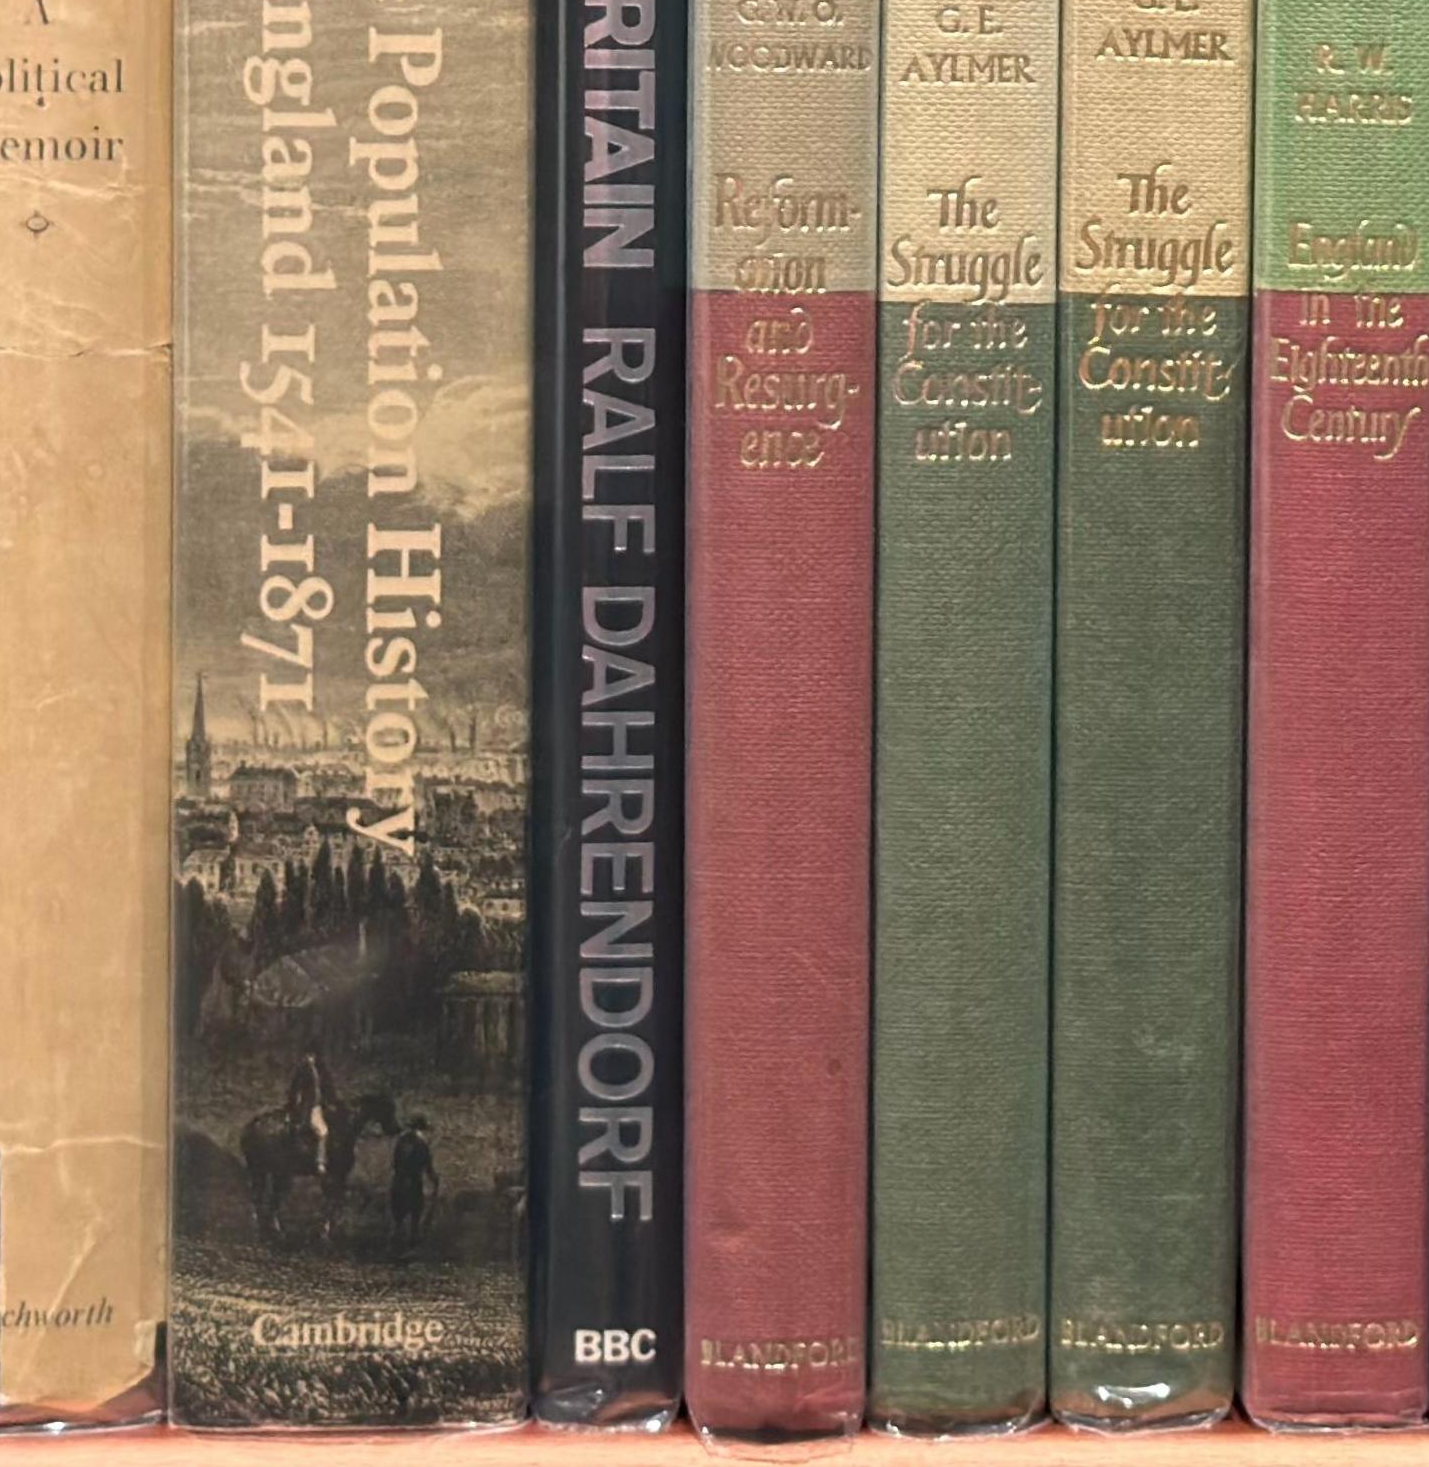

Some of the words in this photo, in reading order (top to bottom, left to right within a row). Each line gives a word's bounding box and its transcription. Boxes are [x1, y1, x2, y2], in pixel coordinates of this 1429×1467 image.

[707, 45, 873, 73] WOODWARD
[899, 54, 1037, 87] AYLMER
[1096, 29, 1235, 65] AYLMER
[1295, 92, 1412, 124] HARRIS
[927, 175, 1002, 234] The
[1117, 162, 1194, 219] The
[349, 28, 445, 495] Population
[888, 234, 1044, 306] Struggle
[1074, 216, 1234, 293] Struggle
[1288, 219, 1419, 281] England
[747, 307, 814, 355] and
[898, 298, 961, 362] for
[970, 304, 1028, 350] the
[1087, 284, 1149, 345] for
[1157, 292, 1217, 336] the
[1354, 289, 1404, 327] the
[581, 327, 655, 555] RALF
[740, 429, 825, 469] ence
[1282, 393, 1421, 461] Century
[239, 322, 335, 713] 1541-1871
[348, 522, 443, 856] History
[577, 585, 655, 1223] DAHRENDORF
[251, 1312, 445, 1352] Cambridge
[574, 1329, 657, 1363] BBC
